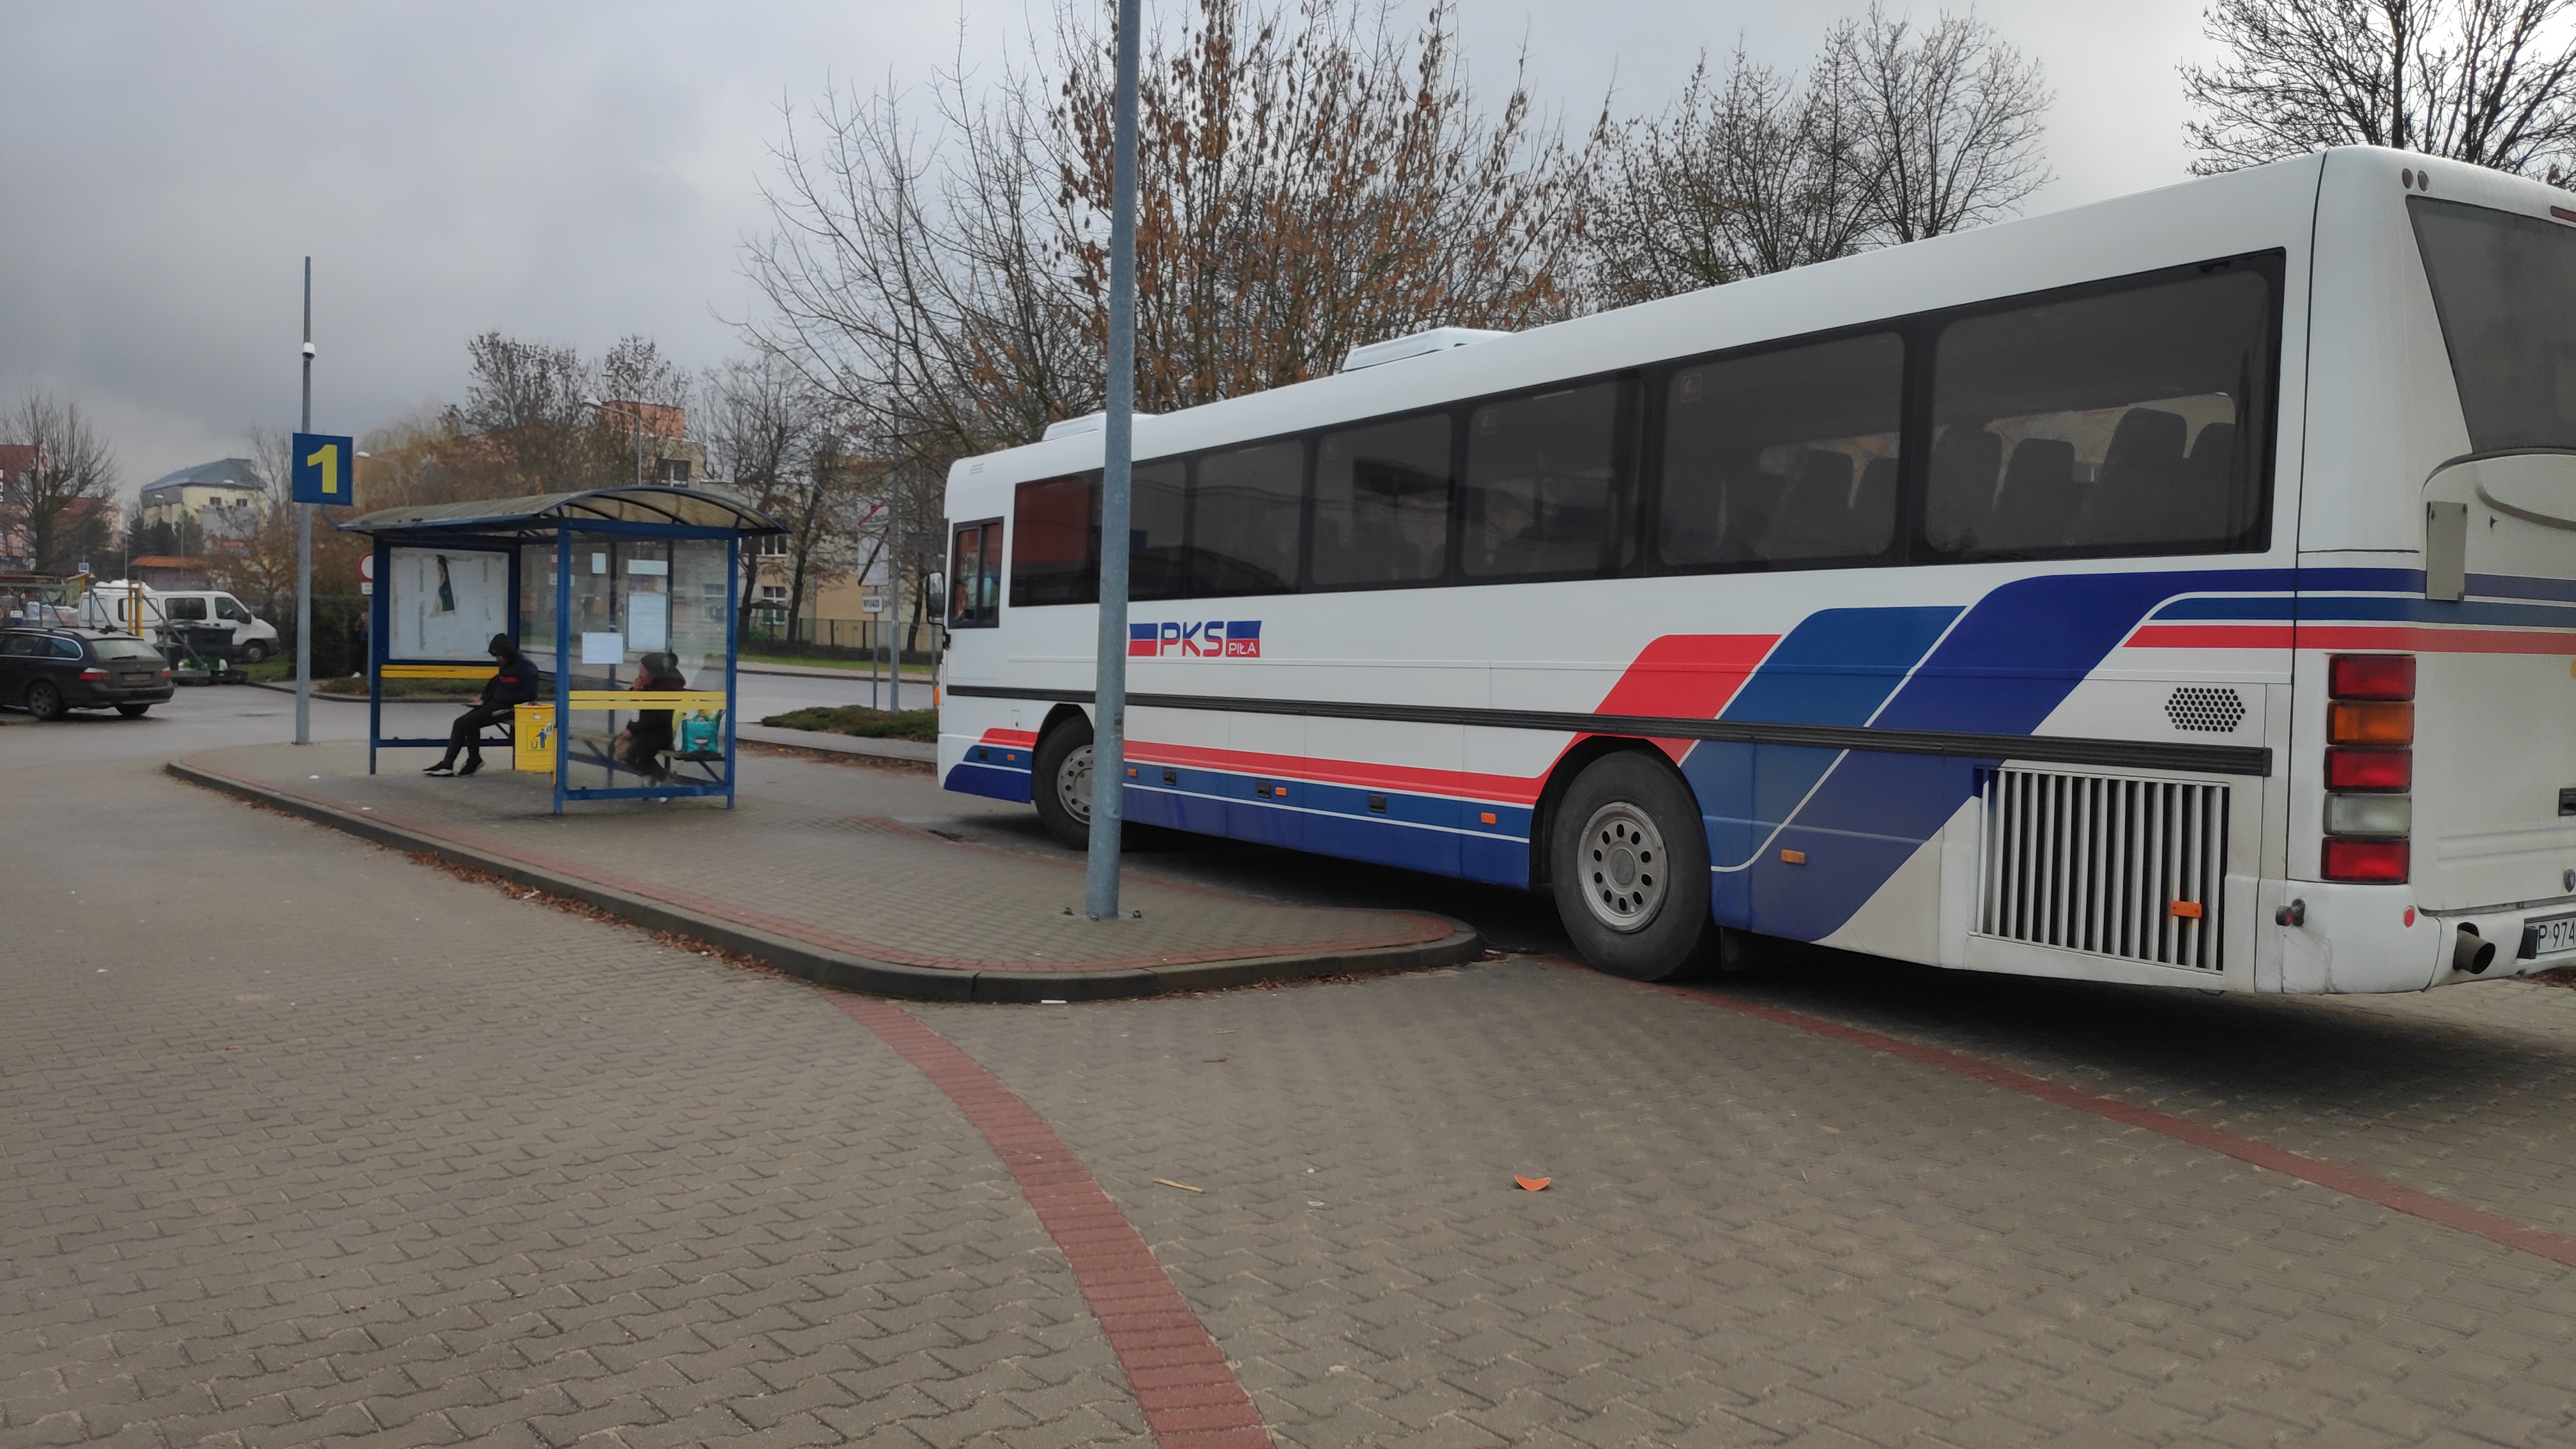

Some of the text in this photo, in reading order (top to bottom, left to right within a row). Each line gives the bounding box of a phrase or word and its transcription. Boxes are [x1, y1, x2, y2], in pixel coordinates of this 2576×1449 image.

[307, 444, 337, 493] 1
[1160, 621, 1224, 657] PKS
[1228, 641, 1257, 656] PIŁA
